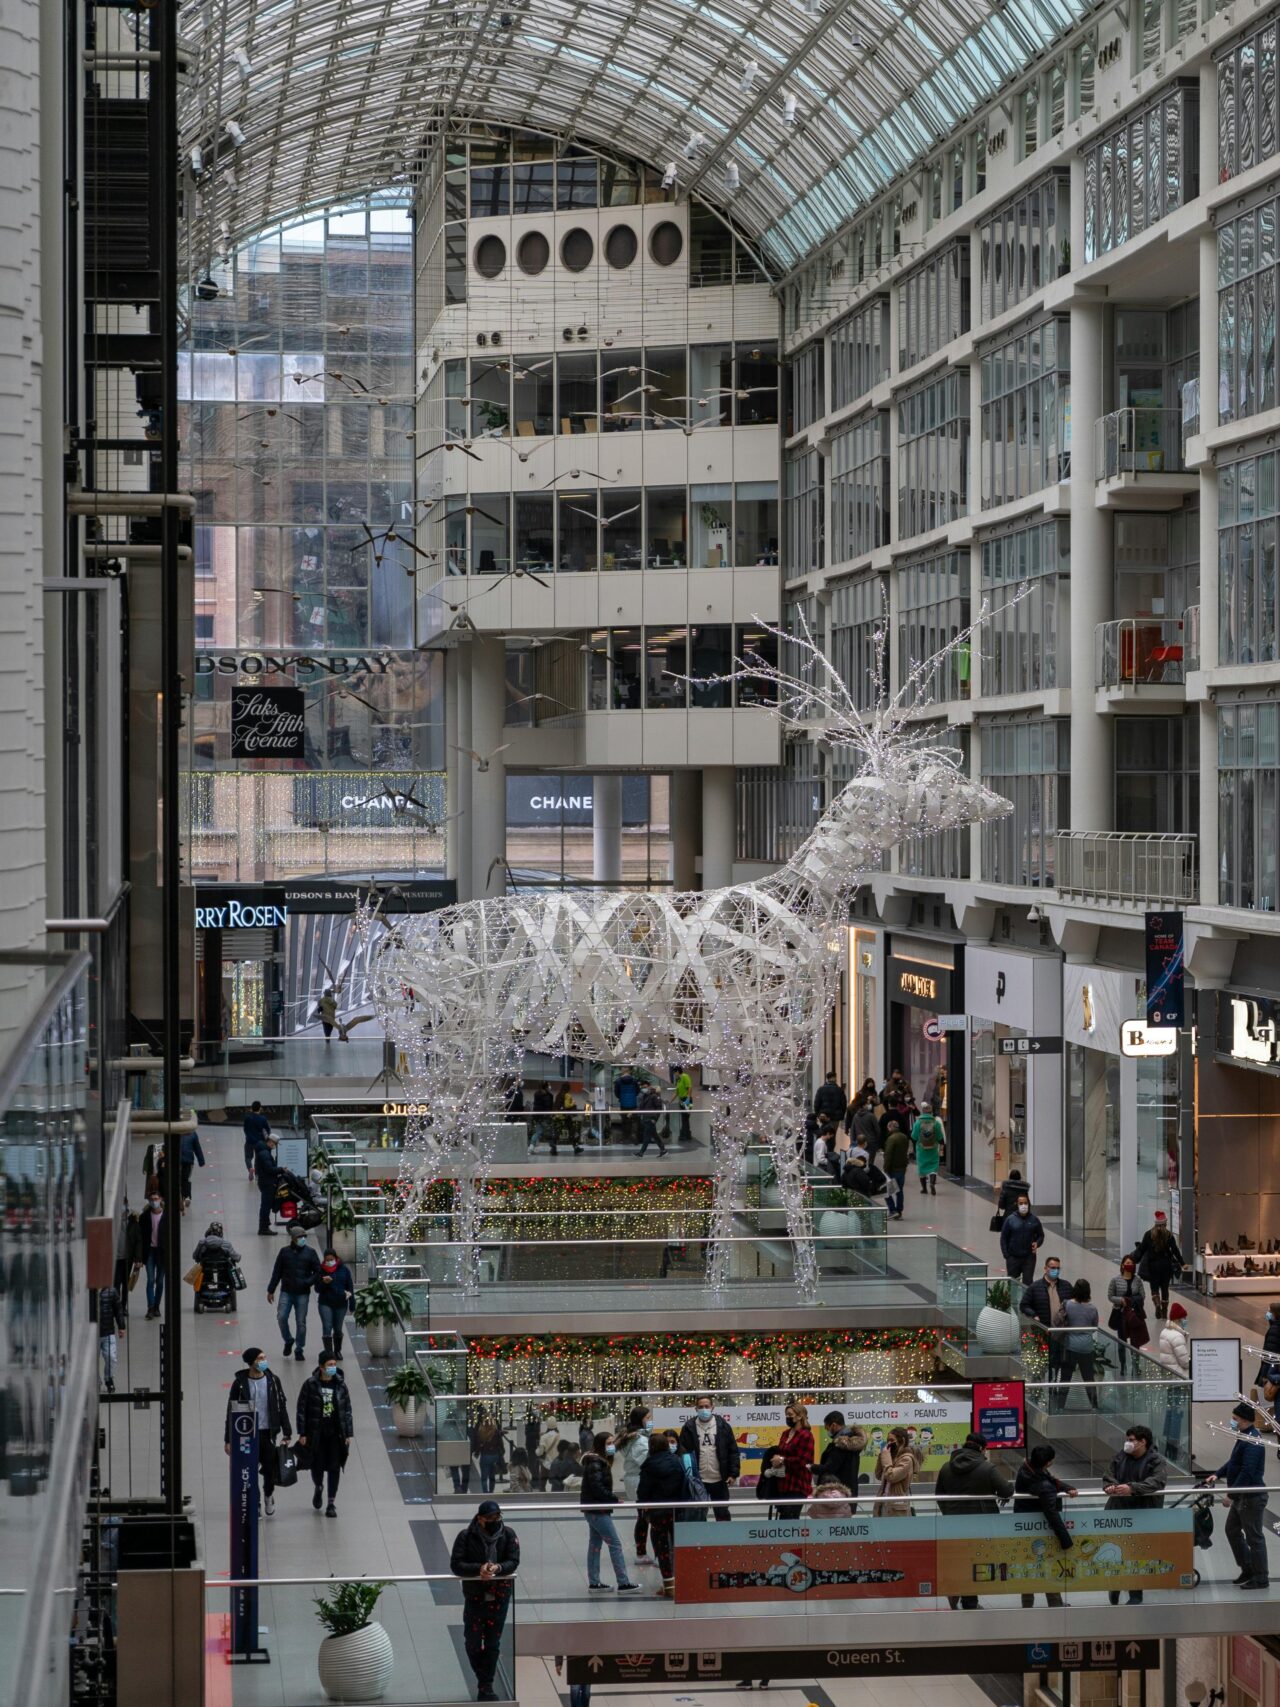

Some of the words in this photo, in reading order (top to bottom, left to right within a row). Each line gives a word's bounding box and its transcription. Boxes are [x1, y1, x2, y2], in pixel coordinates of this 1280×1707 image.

[328, 656, 393, 675] BAY
[231, 693, 280, 721] Saks
[231, 724, 299, 751] Avenue
[530, 796, 593, 810] CHANE
[195, 906, 228, 929] RRY
[227, 900, 288, 928] ROSEN
[746, 1411, 781, 1422] PEANUTS
[847, 1409, 891, 1420] swatch
[914, 1408, 948, 1418] PEANUTS
[1014, 1520, 1049, 1531] swat
[1093, 1517, 1133, 1529] PEANUTS
[748, 1526, 801, 1539] swatch
[829, 1525, 869, 1537] PEANUTS
[826, 1650, 880, 1665] Queen
[885, 1649, 905, 1663] St.
